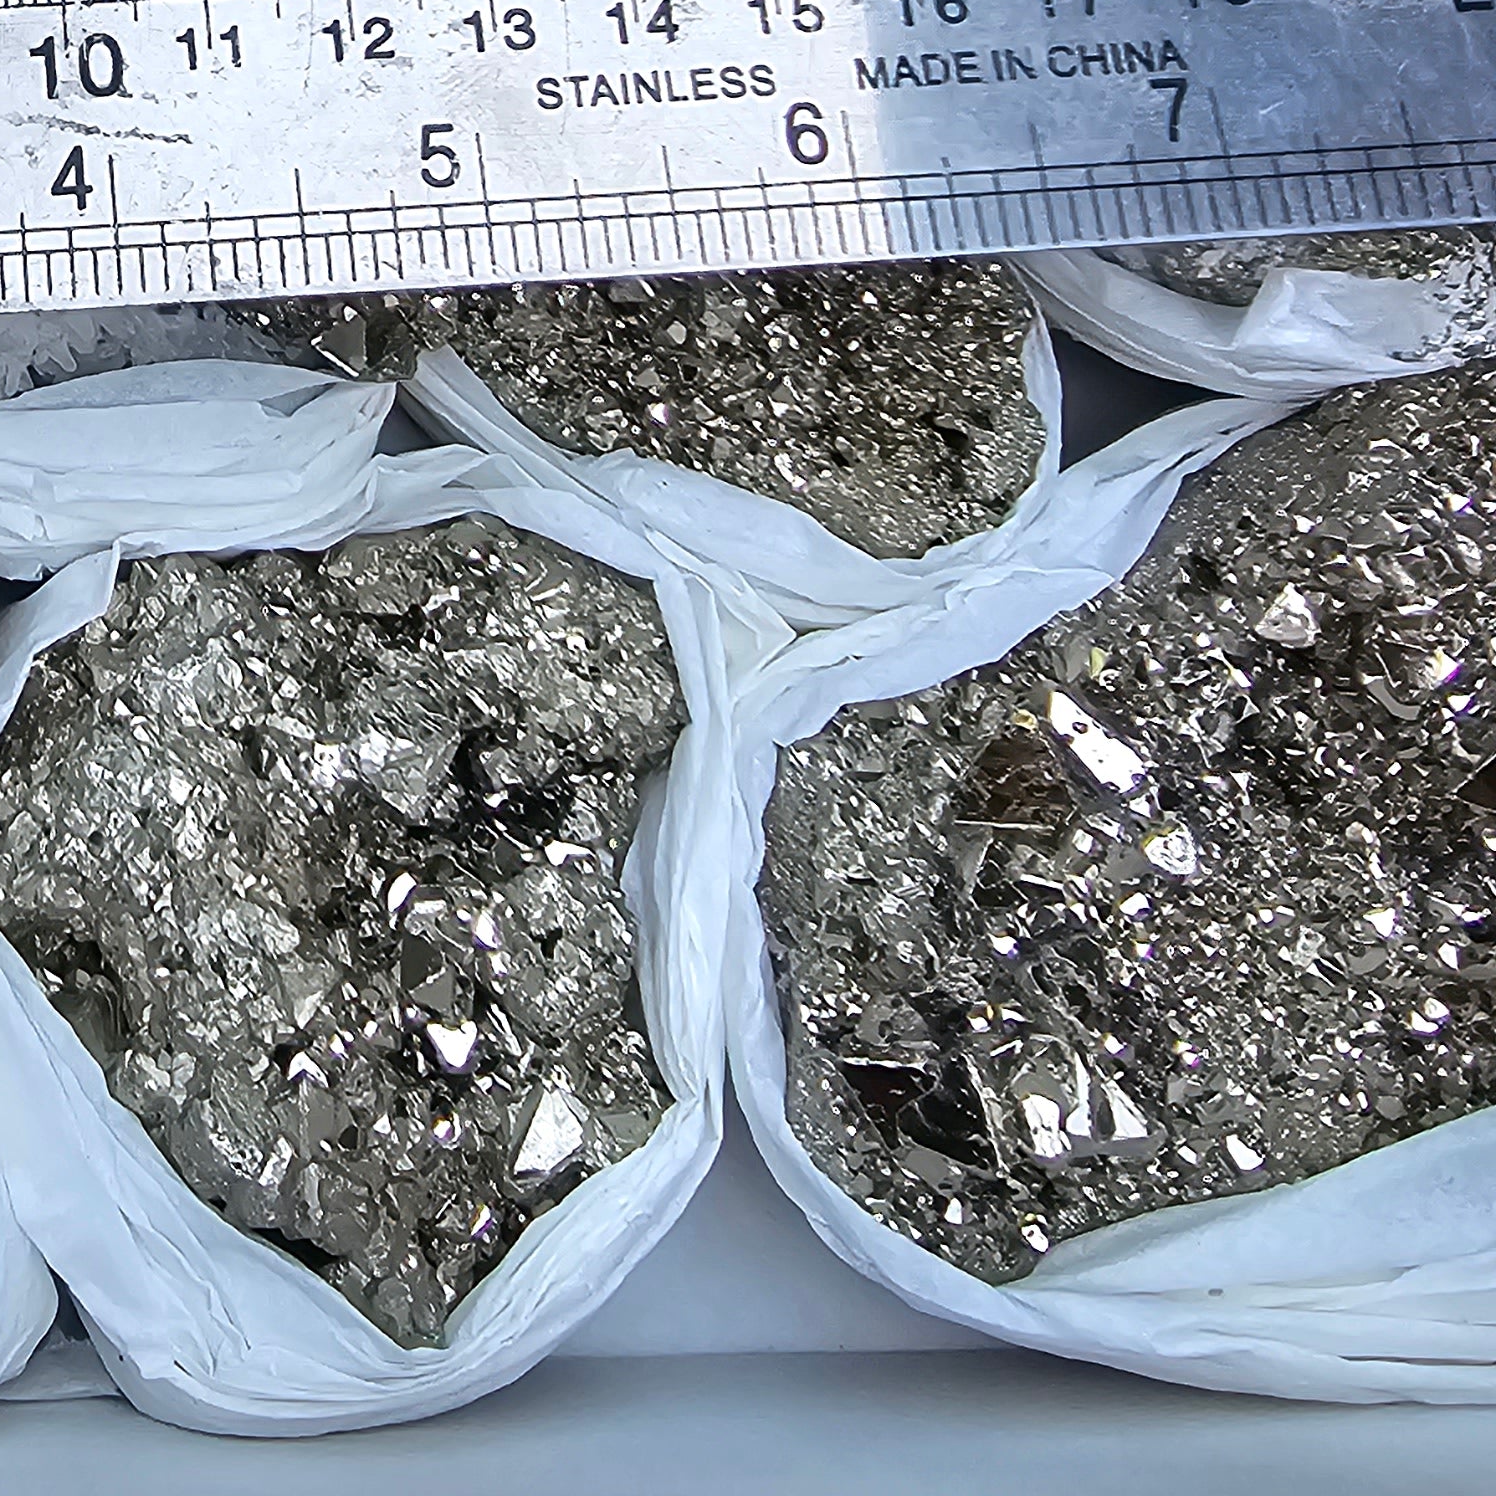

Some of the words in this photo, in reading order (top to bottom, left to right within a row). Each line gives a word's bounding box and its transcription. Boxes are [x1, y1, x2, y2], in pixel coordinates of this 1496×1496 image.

[29, 32, 126, 100] 10
[175, 26, 242, 68] 11
[322, 16, 395, 62] 12
[462, 8, 536, 53] 13
[606, 0, 679, 44] 14
[535, 64, 778, 110] STAINLESS
[855, 49, 982, 90] MADE
[992, 48, 1038, 81] IN
[1048, 39, 1189, 78] CHINA
[50, 146, 93, 210] 4
[420, 123, 459, 188] 5
[784, 102, 829, 165] 6
[1149, 78, 1188, 142] 7
